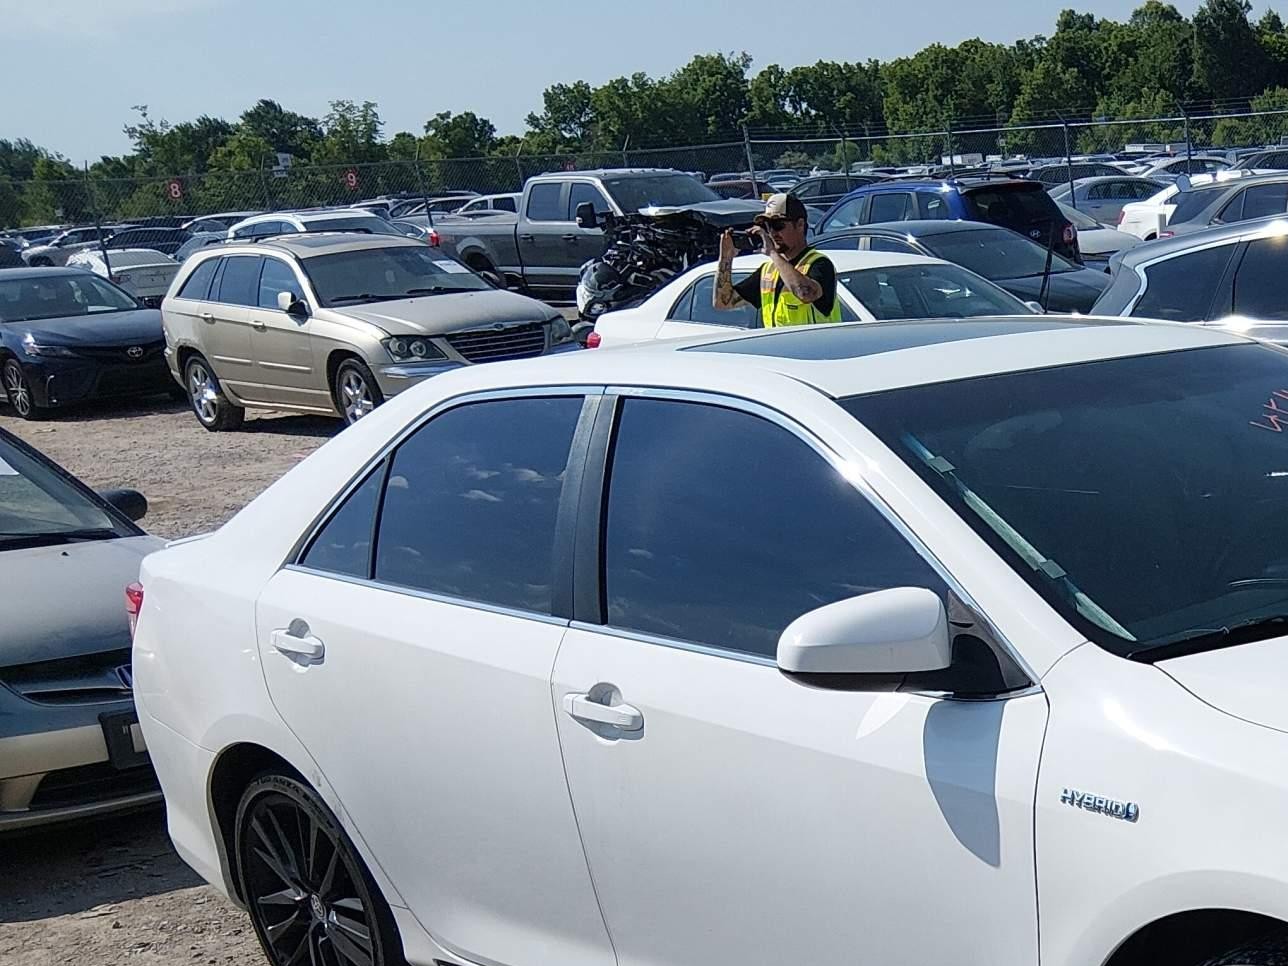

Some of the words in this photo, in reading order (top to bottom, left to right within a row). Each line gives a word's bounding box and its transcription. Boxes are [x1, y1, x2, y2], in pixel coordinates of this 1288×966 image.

[347, 172, 357, 187] 9
[170, 182, 181, 198] 8
[1060, 788, 1126, 820] HYBRID
